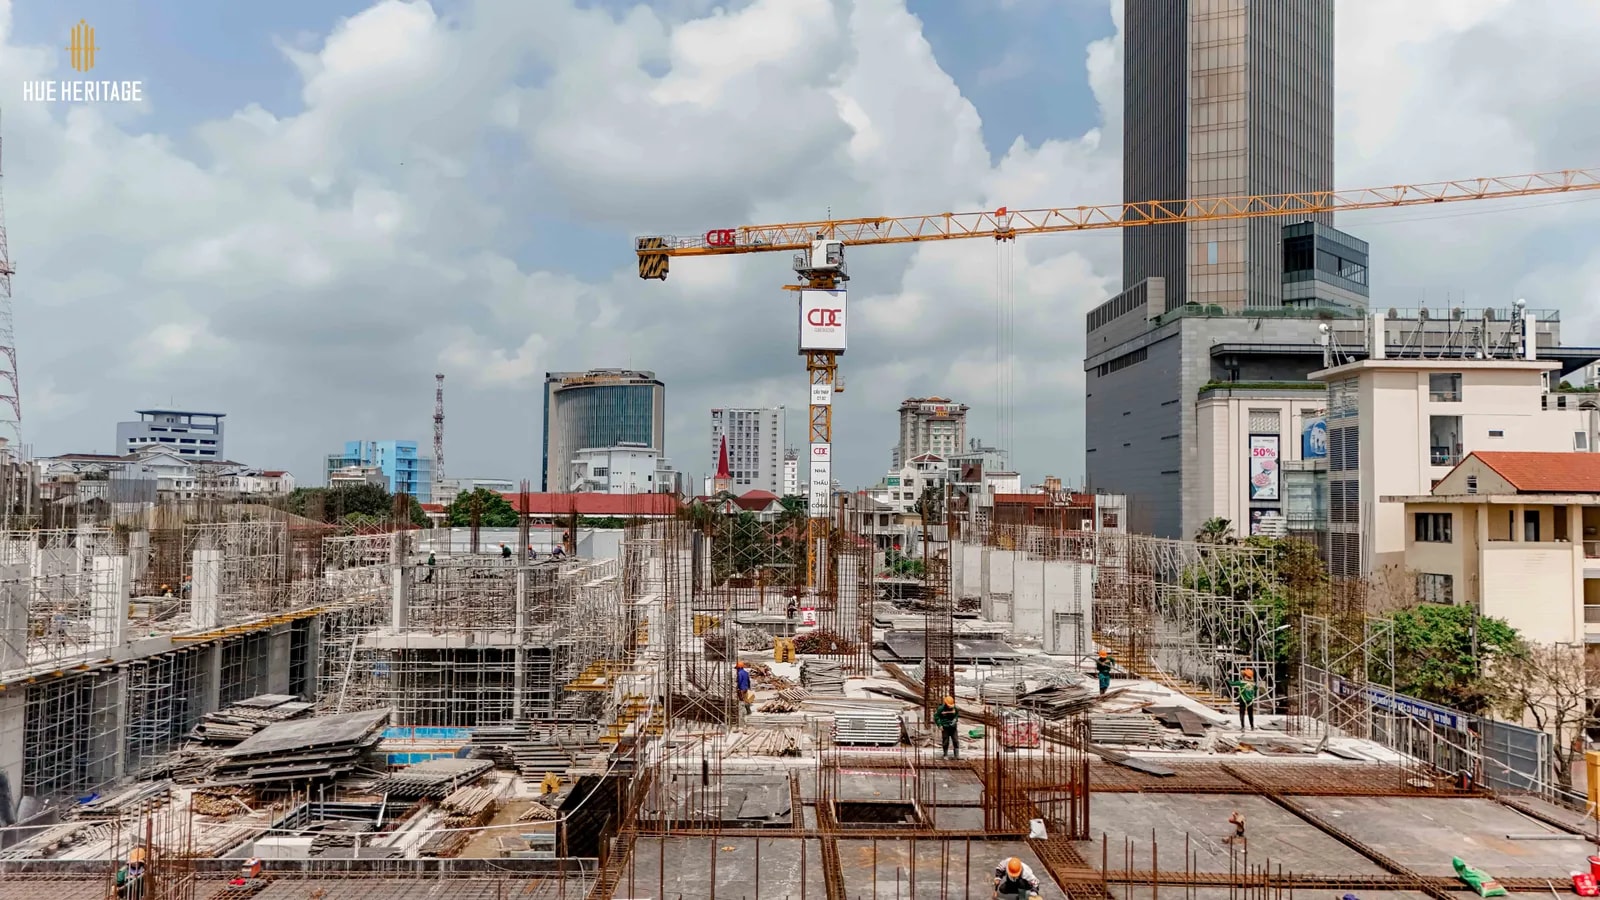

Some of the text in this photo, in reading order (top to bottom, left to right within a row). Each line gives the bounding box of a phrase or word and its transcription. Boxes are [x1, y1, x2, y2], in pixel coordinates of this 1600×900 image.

[706, 229, 736, 246] CDC
[807, 308, 842, 327] CDC
[813, 447, 828, 455] CDC
[1253, 447, 1276, 457] 50%
